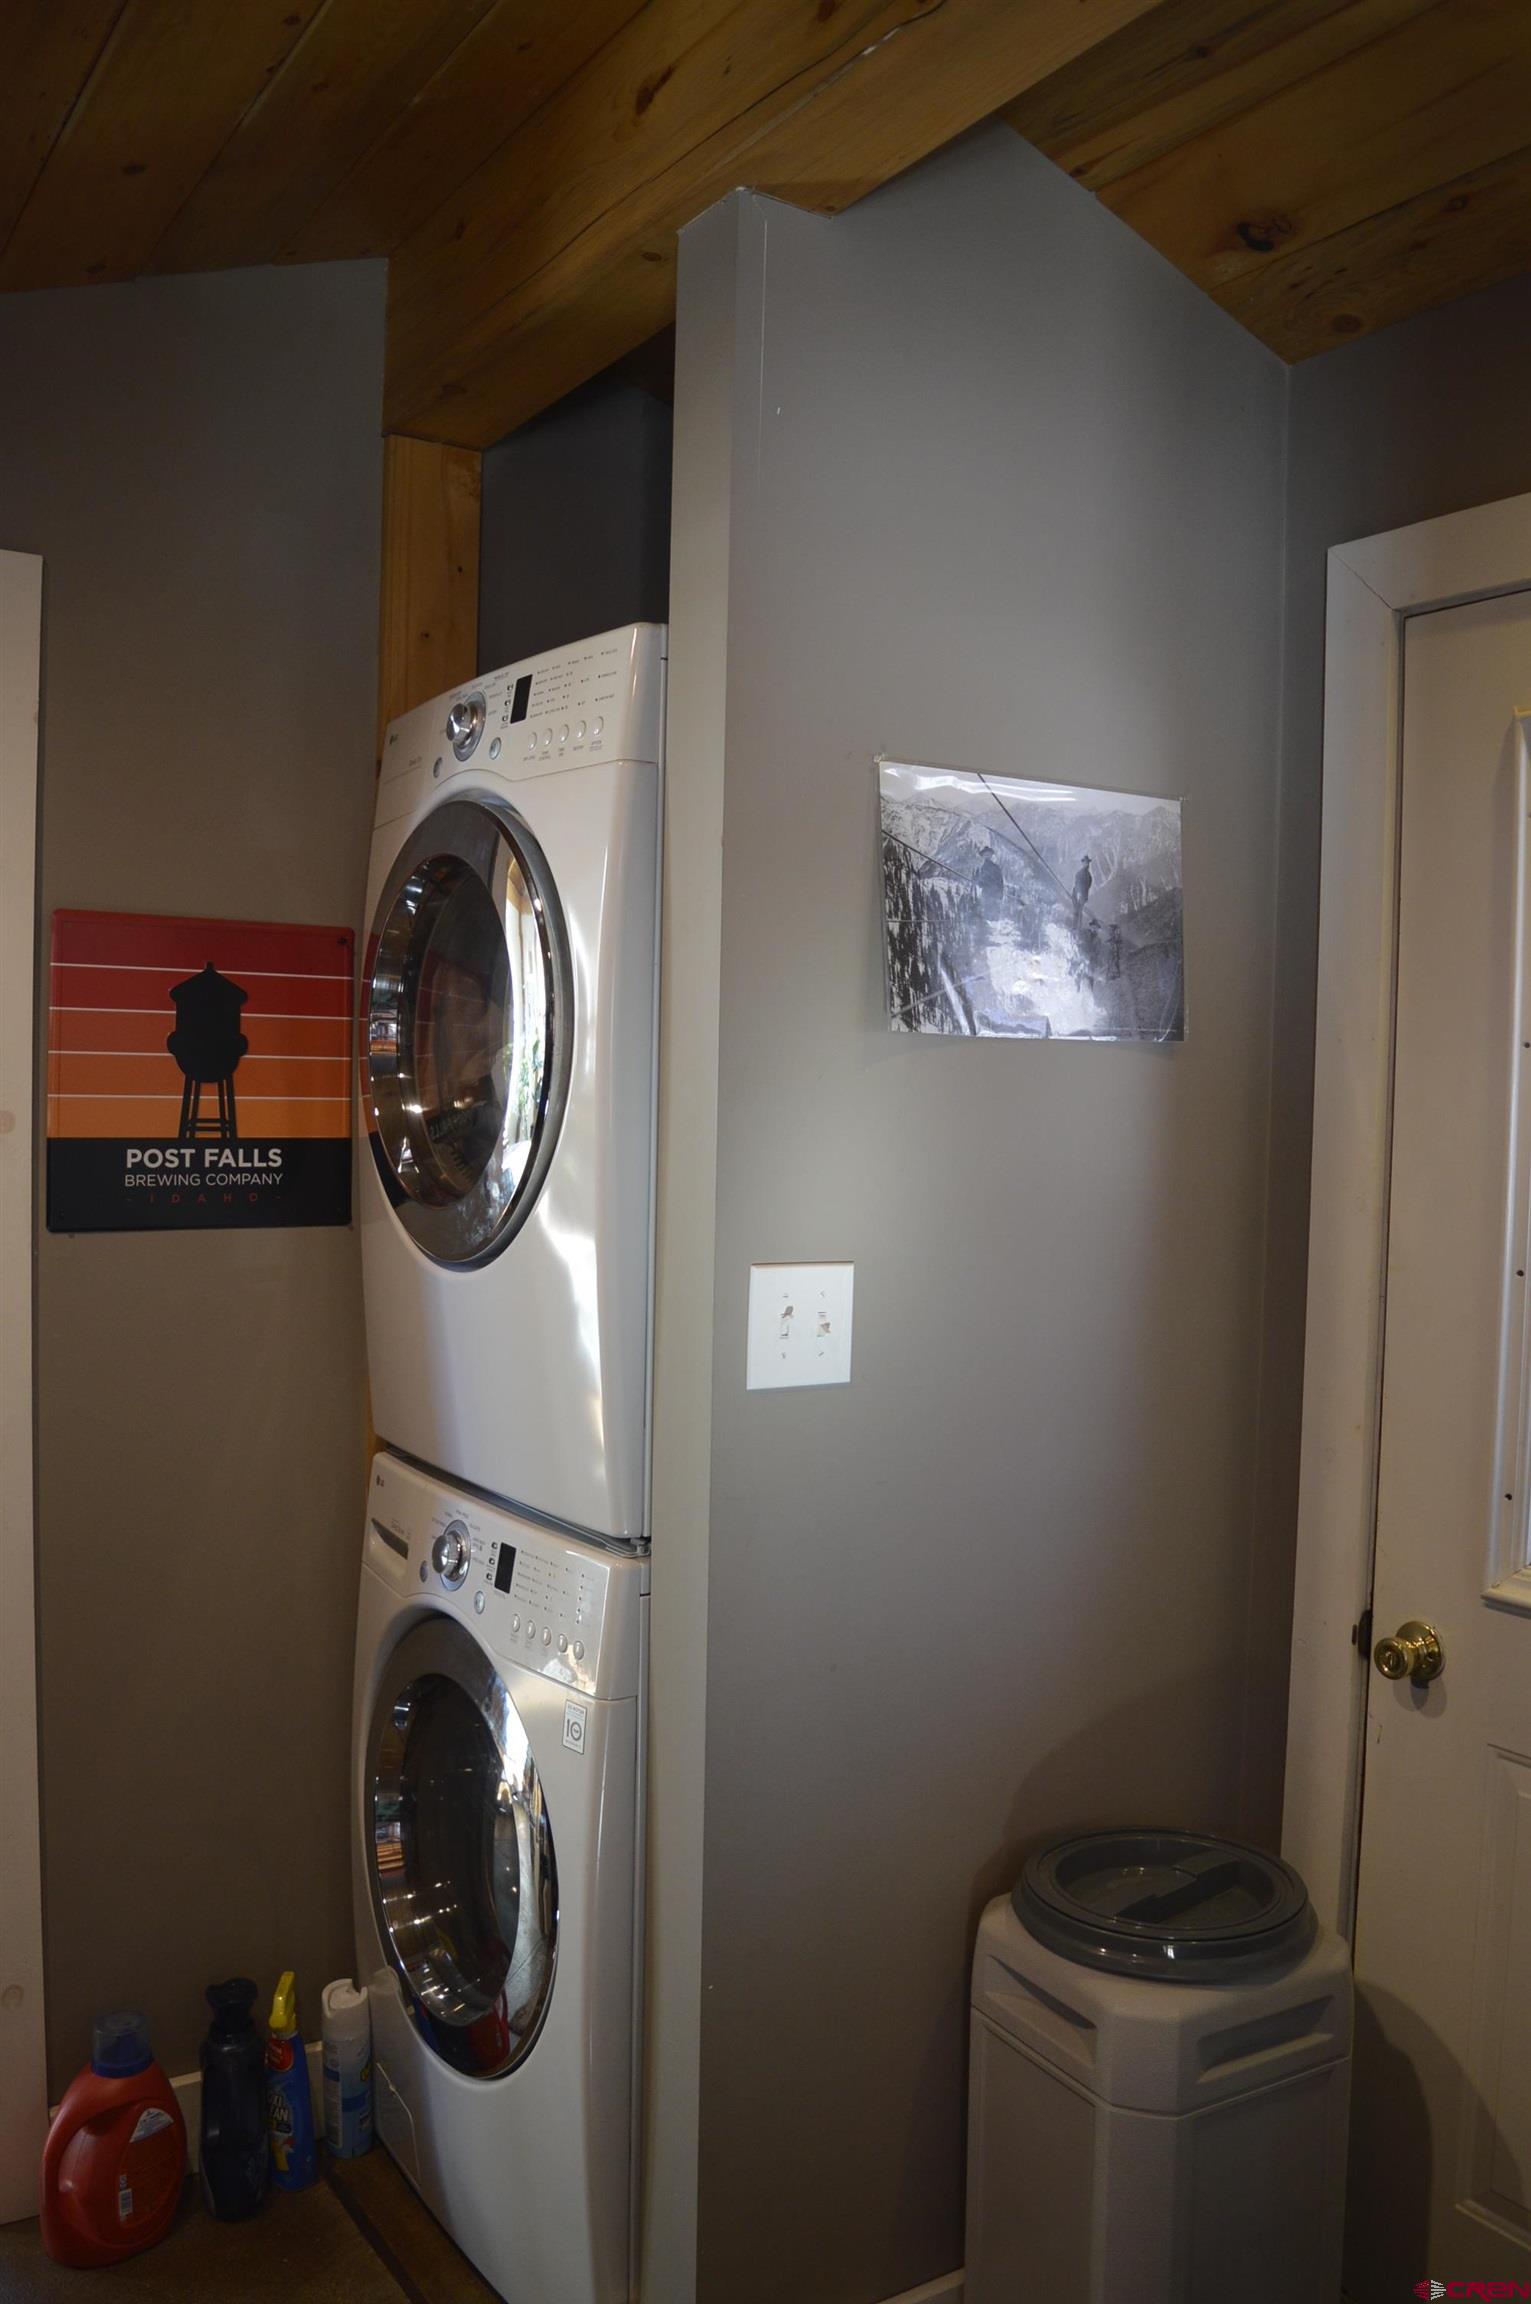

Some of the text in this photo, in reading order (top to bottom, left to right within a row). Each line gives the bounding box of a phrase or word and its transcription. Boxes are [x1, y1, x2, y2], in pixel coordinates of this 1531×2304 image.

[125, 1147, 283, 1169] POST FALLS
[124, 1172, 284, 1188] BREWING COMPANY
